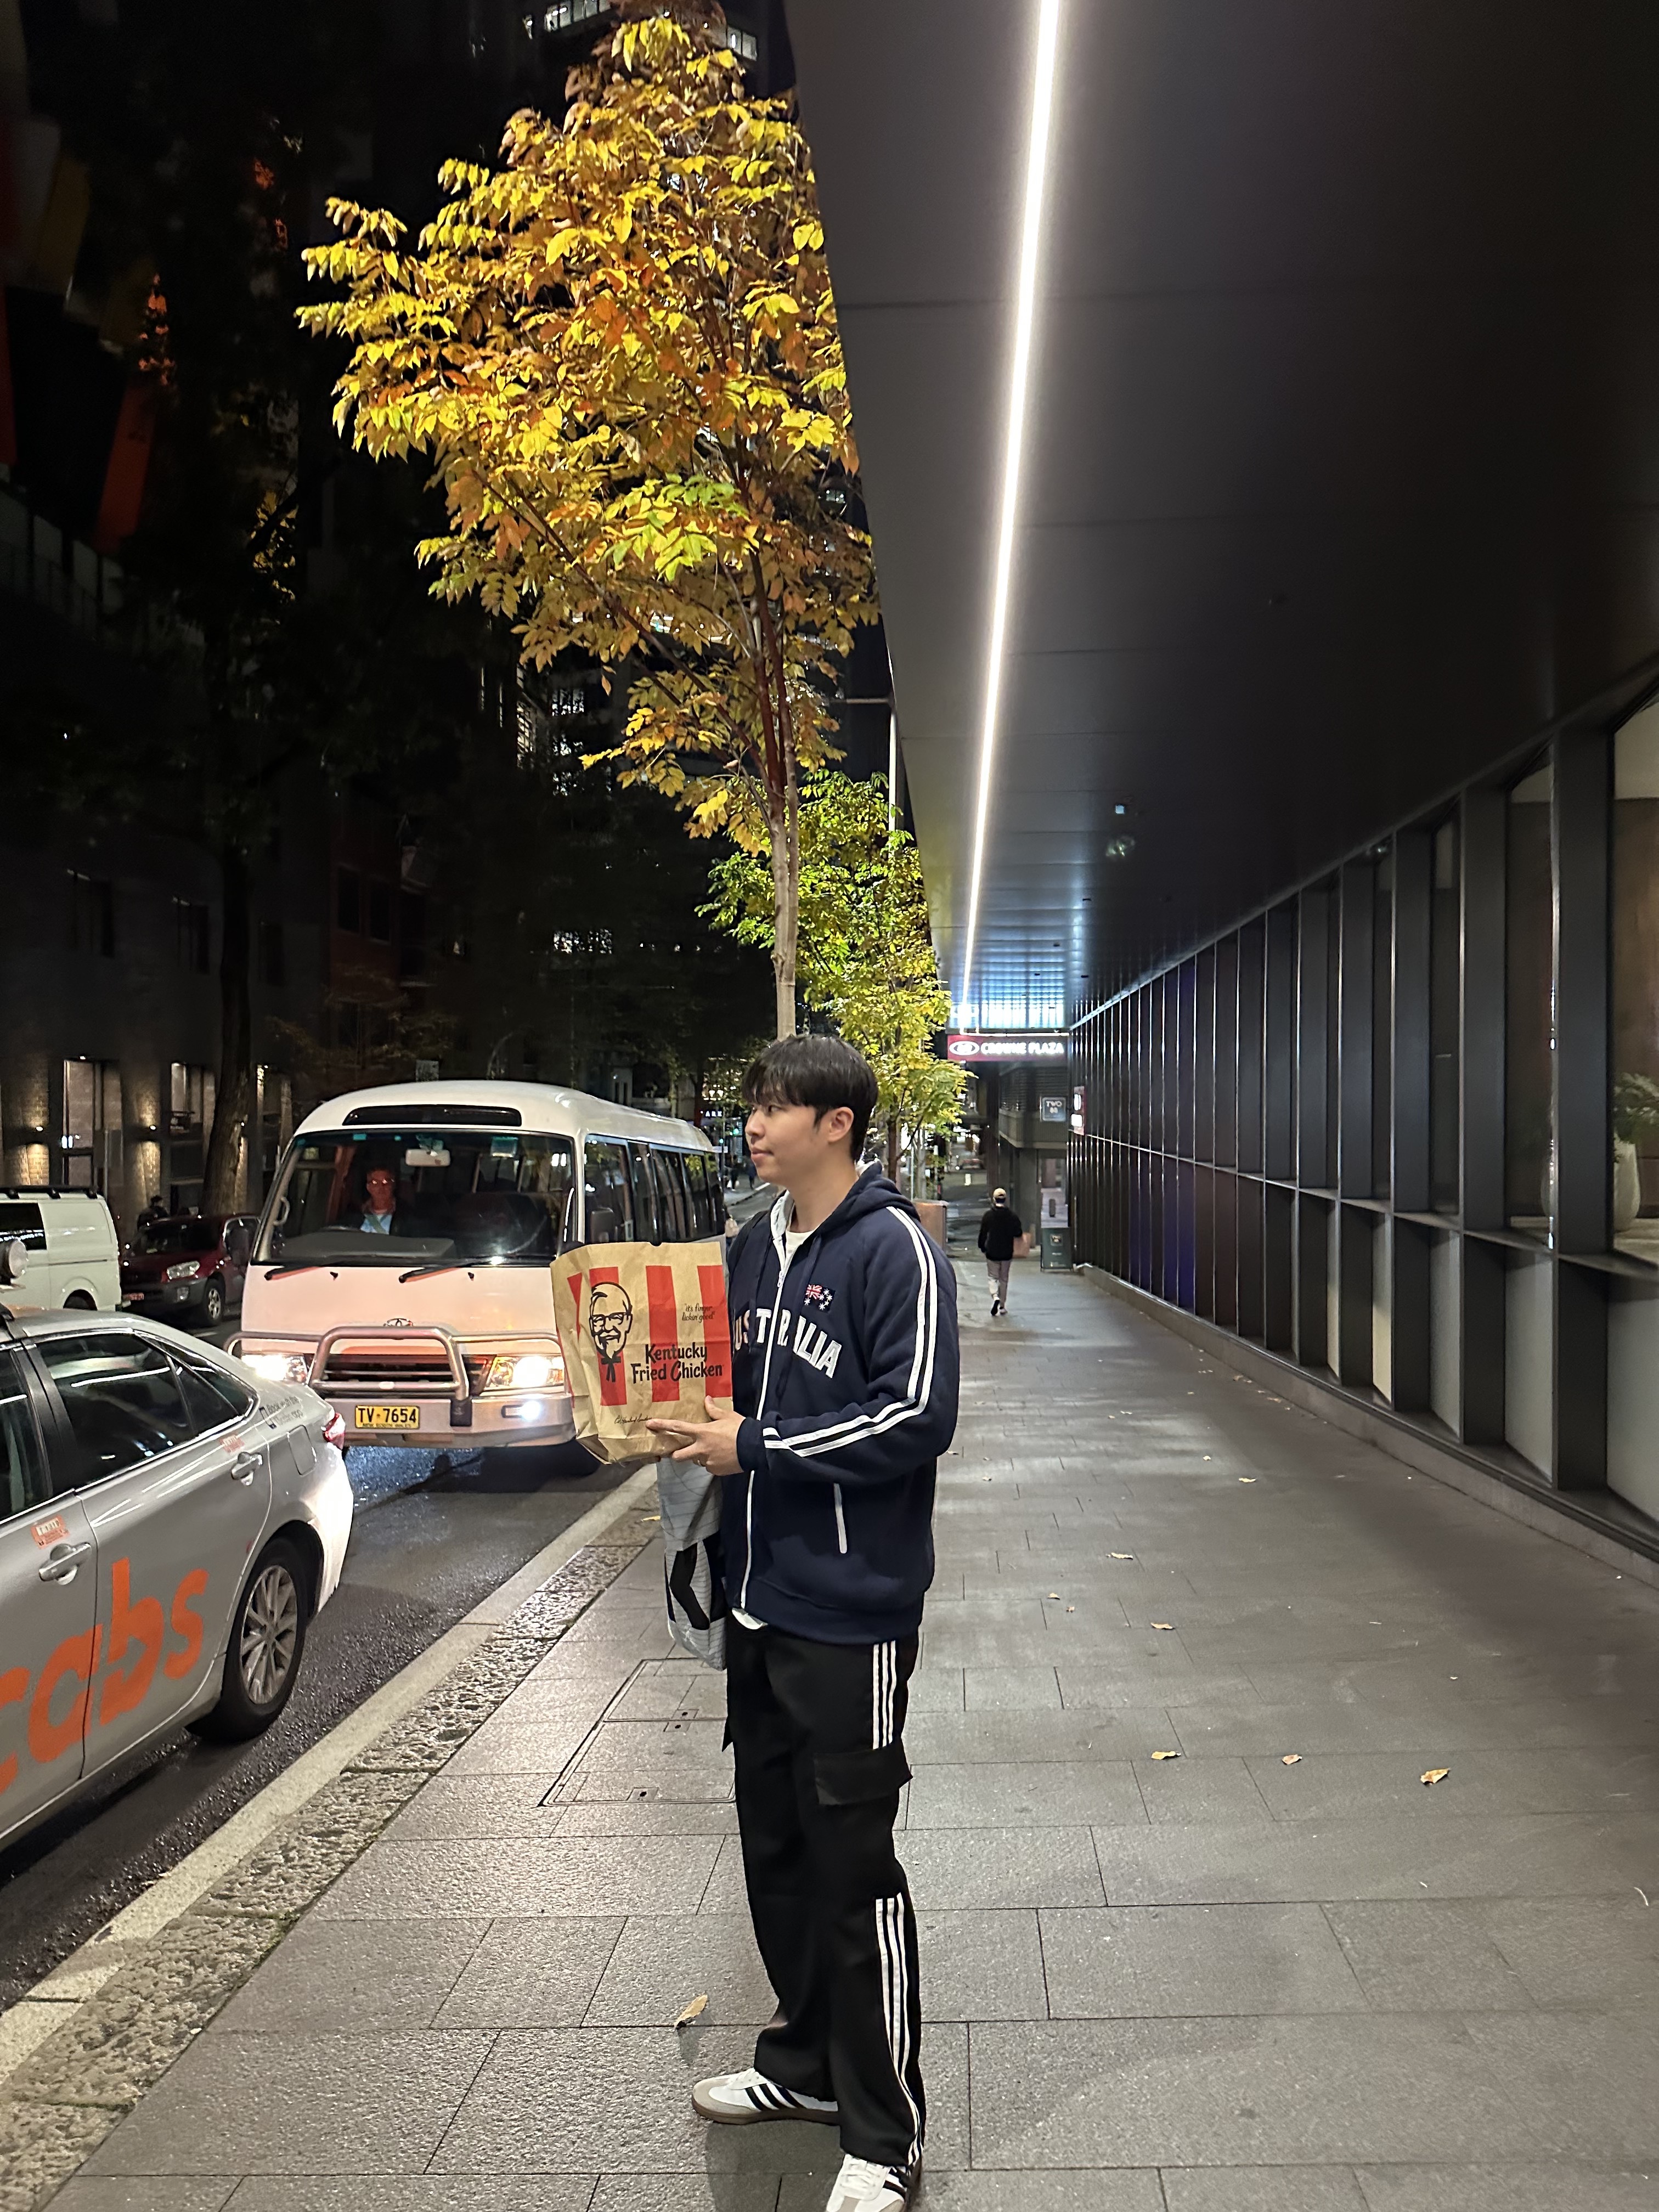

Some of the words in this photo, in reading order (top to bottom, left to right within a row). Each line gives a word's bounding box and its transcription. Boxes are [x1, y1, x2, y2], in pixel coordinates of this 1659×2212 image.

[980, 1042, 1027, 1054] CROWNE
[1028, 1042, 1064, 1054] PLAZA
[645, 1341, 708, 1365] Kentucky
[735, 1308, 843, 1379] USTRLIA
[630, 1363, 667, 1384] Fried
[670, 1360, 723, 1382] Chicken
[382, 1408, 417, 1423] 7654
